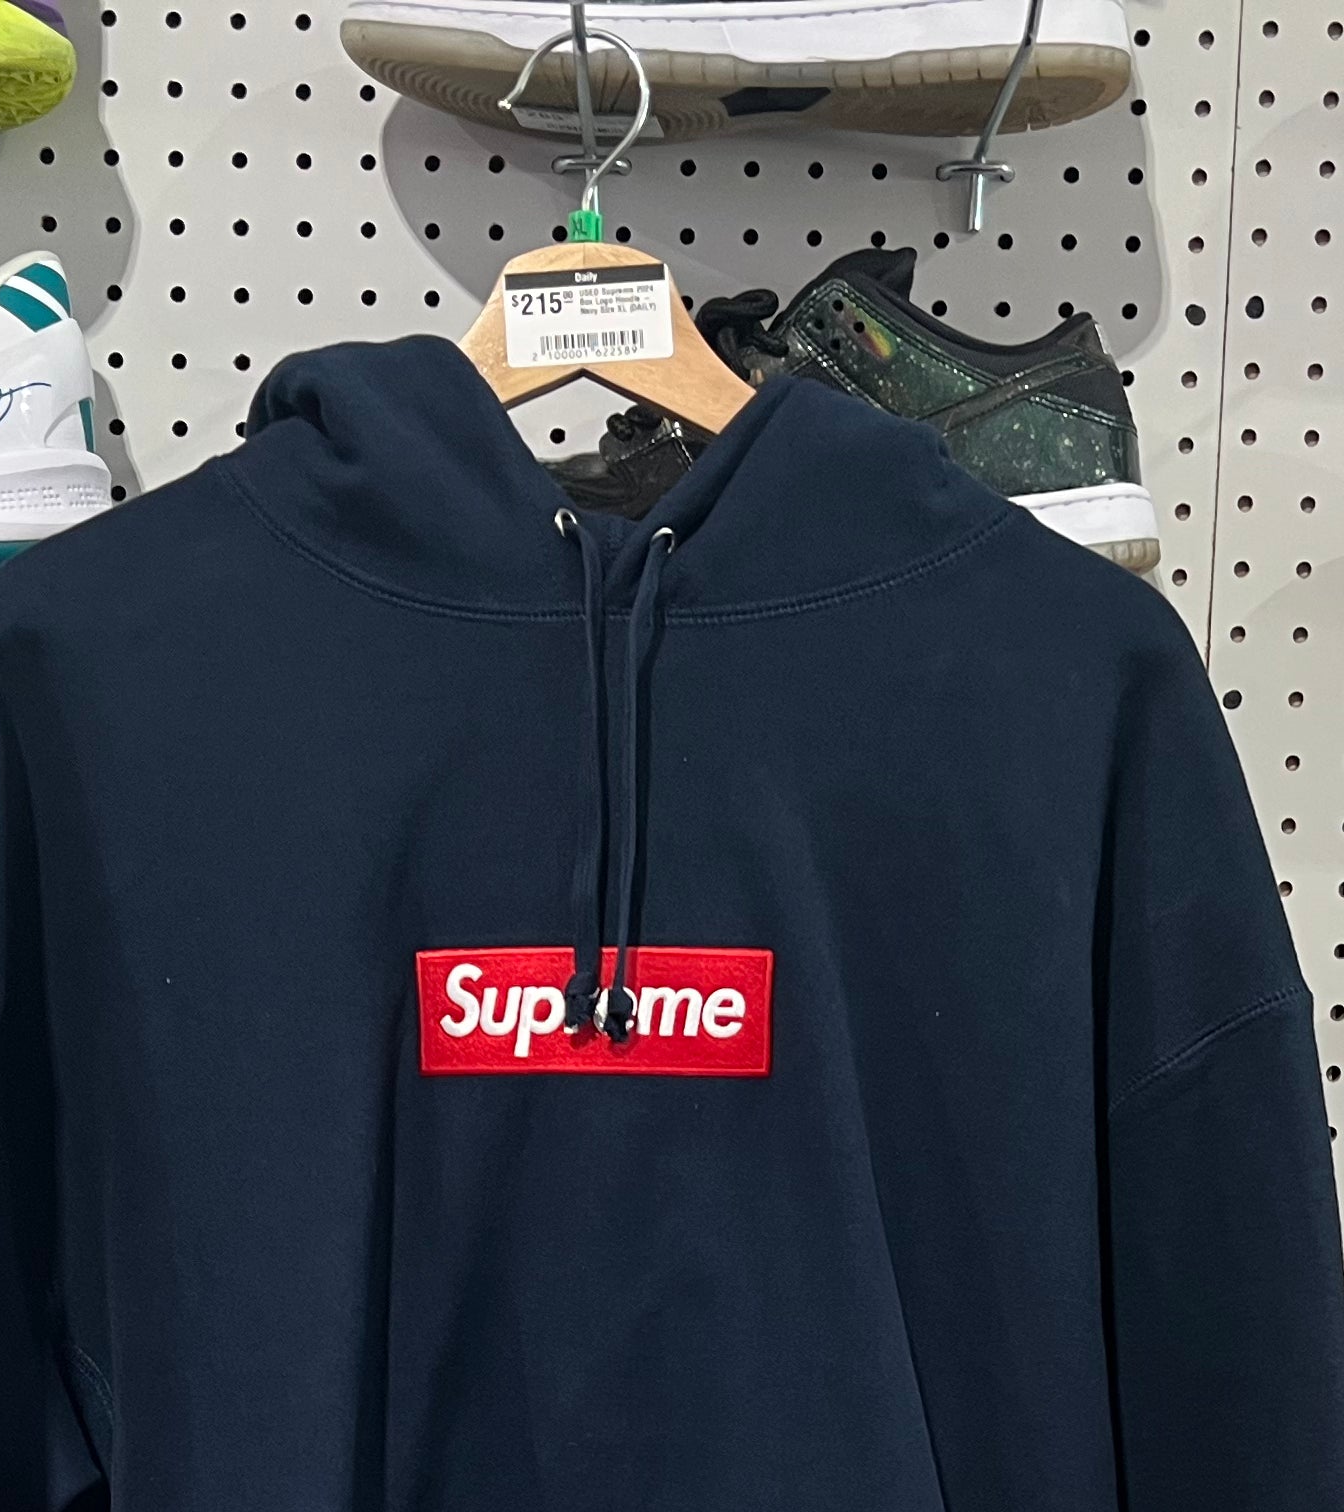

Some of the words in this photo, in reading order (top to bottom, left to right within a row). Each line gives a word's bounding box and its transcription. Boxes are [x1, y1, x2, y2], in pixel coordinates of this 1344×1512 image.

[571, 217, 587, 236] XL
[574, 272, 598, 283] Daily
[579, 287, 599, 297] USED
[601, 286, 634, 297] Supreme
[595, 296, 613, 306] Logo
[617, 304, 628, 313] XL
[630, 303, 657, 314] (DAILY)
[440, 963, 746, 1058] Supme
